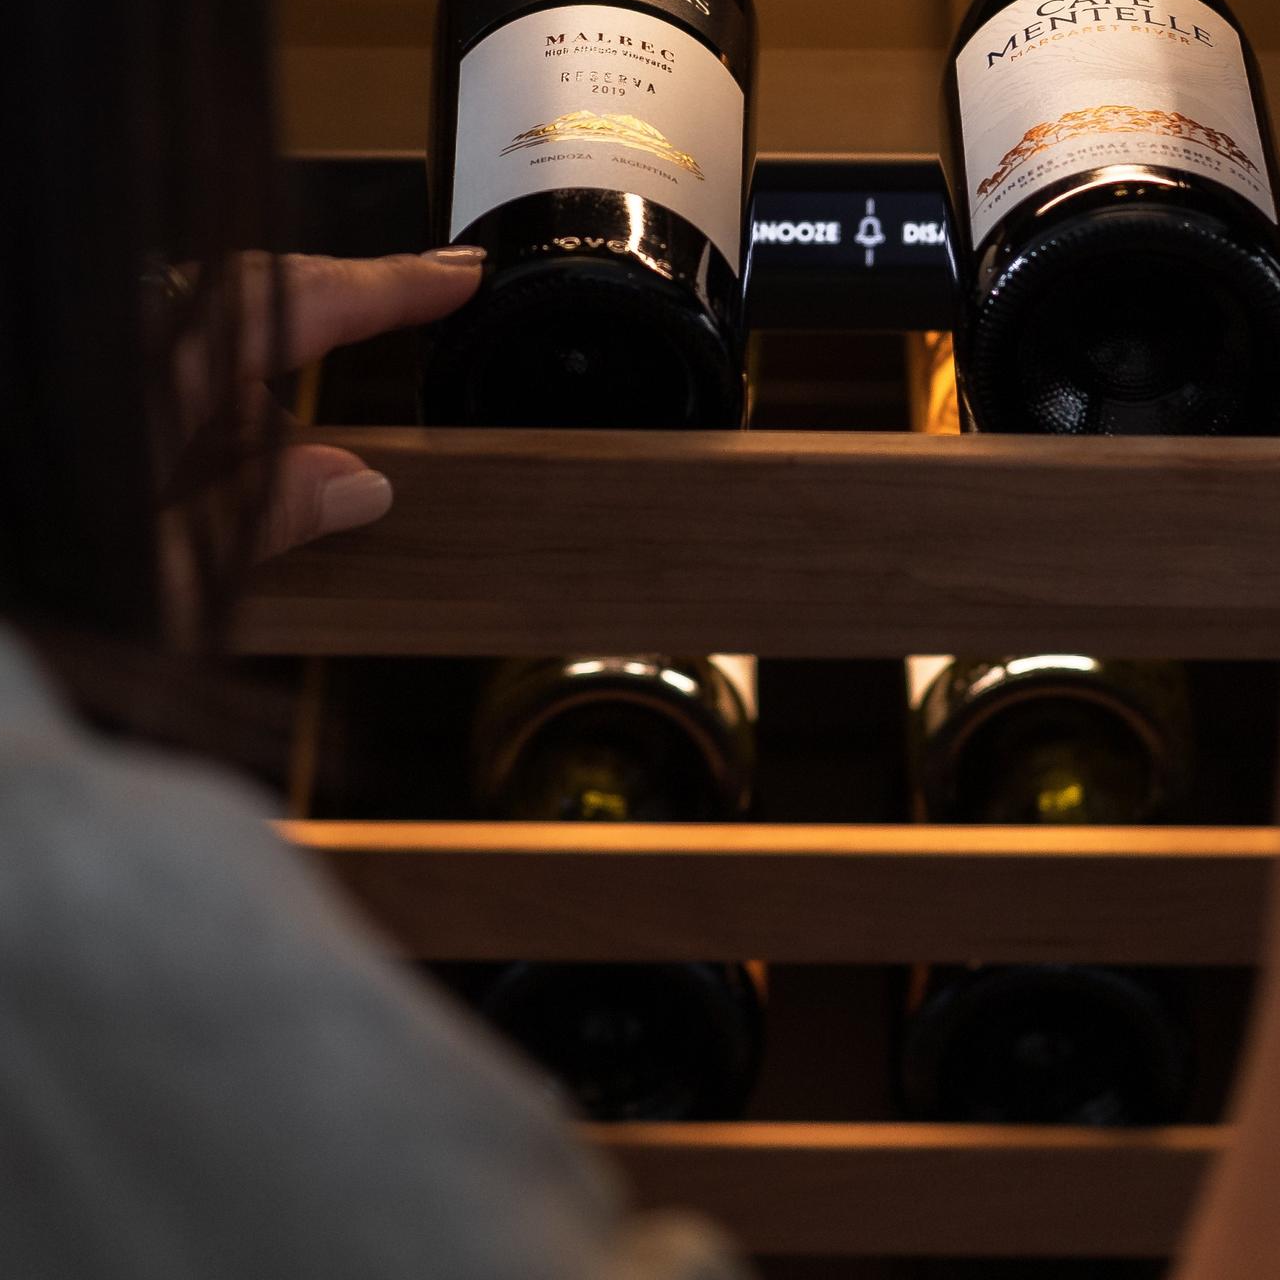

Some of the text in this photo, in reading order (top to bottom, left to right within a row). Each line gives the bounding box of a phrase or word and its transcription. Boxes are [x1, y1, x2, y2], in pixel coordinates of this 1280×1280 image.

[545, 32, 675, 63] MALBEC
[986, 6, 1214, 70] MENTELLE
[1010, 24, 1191, 63] MARGARET RIVER
[544, 47, 569, 58] High
[622, 49, 673, 73] Vineyards
[560, 71, 657, 95] RESERVA
[591, 84, 626, 97] 2019
[529, 153, 679, 184] MENDOZA ARGENTINA
